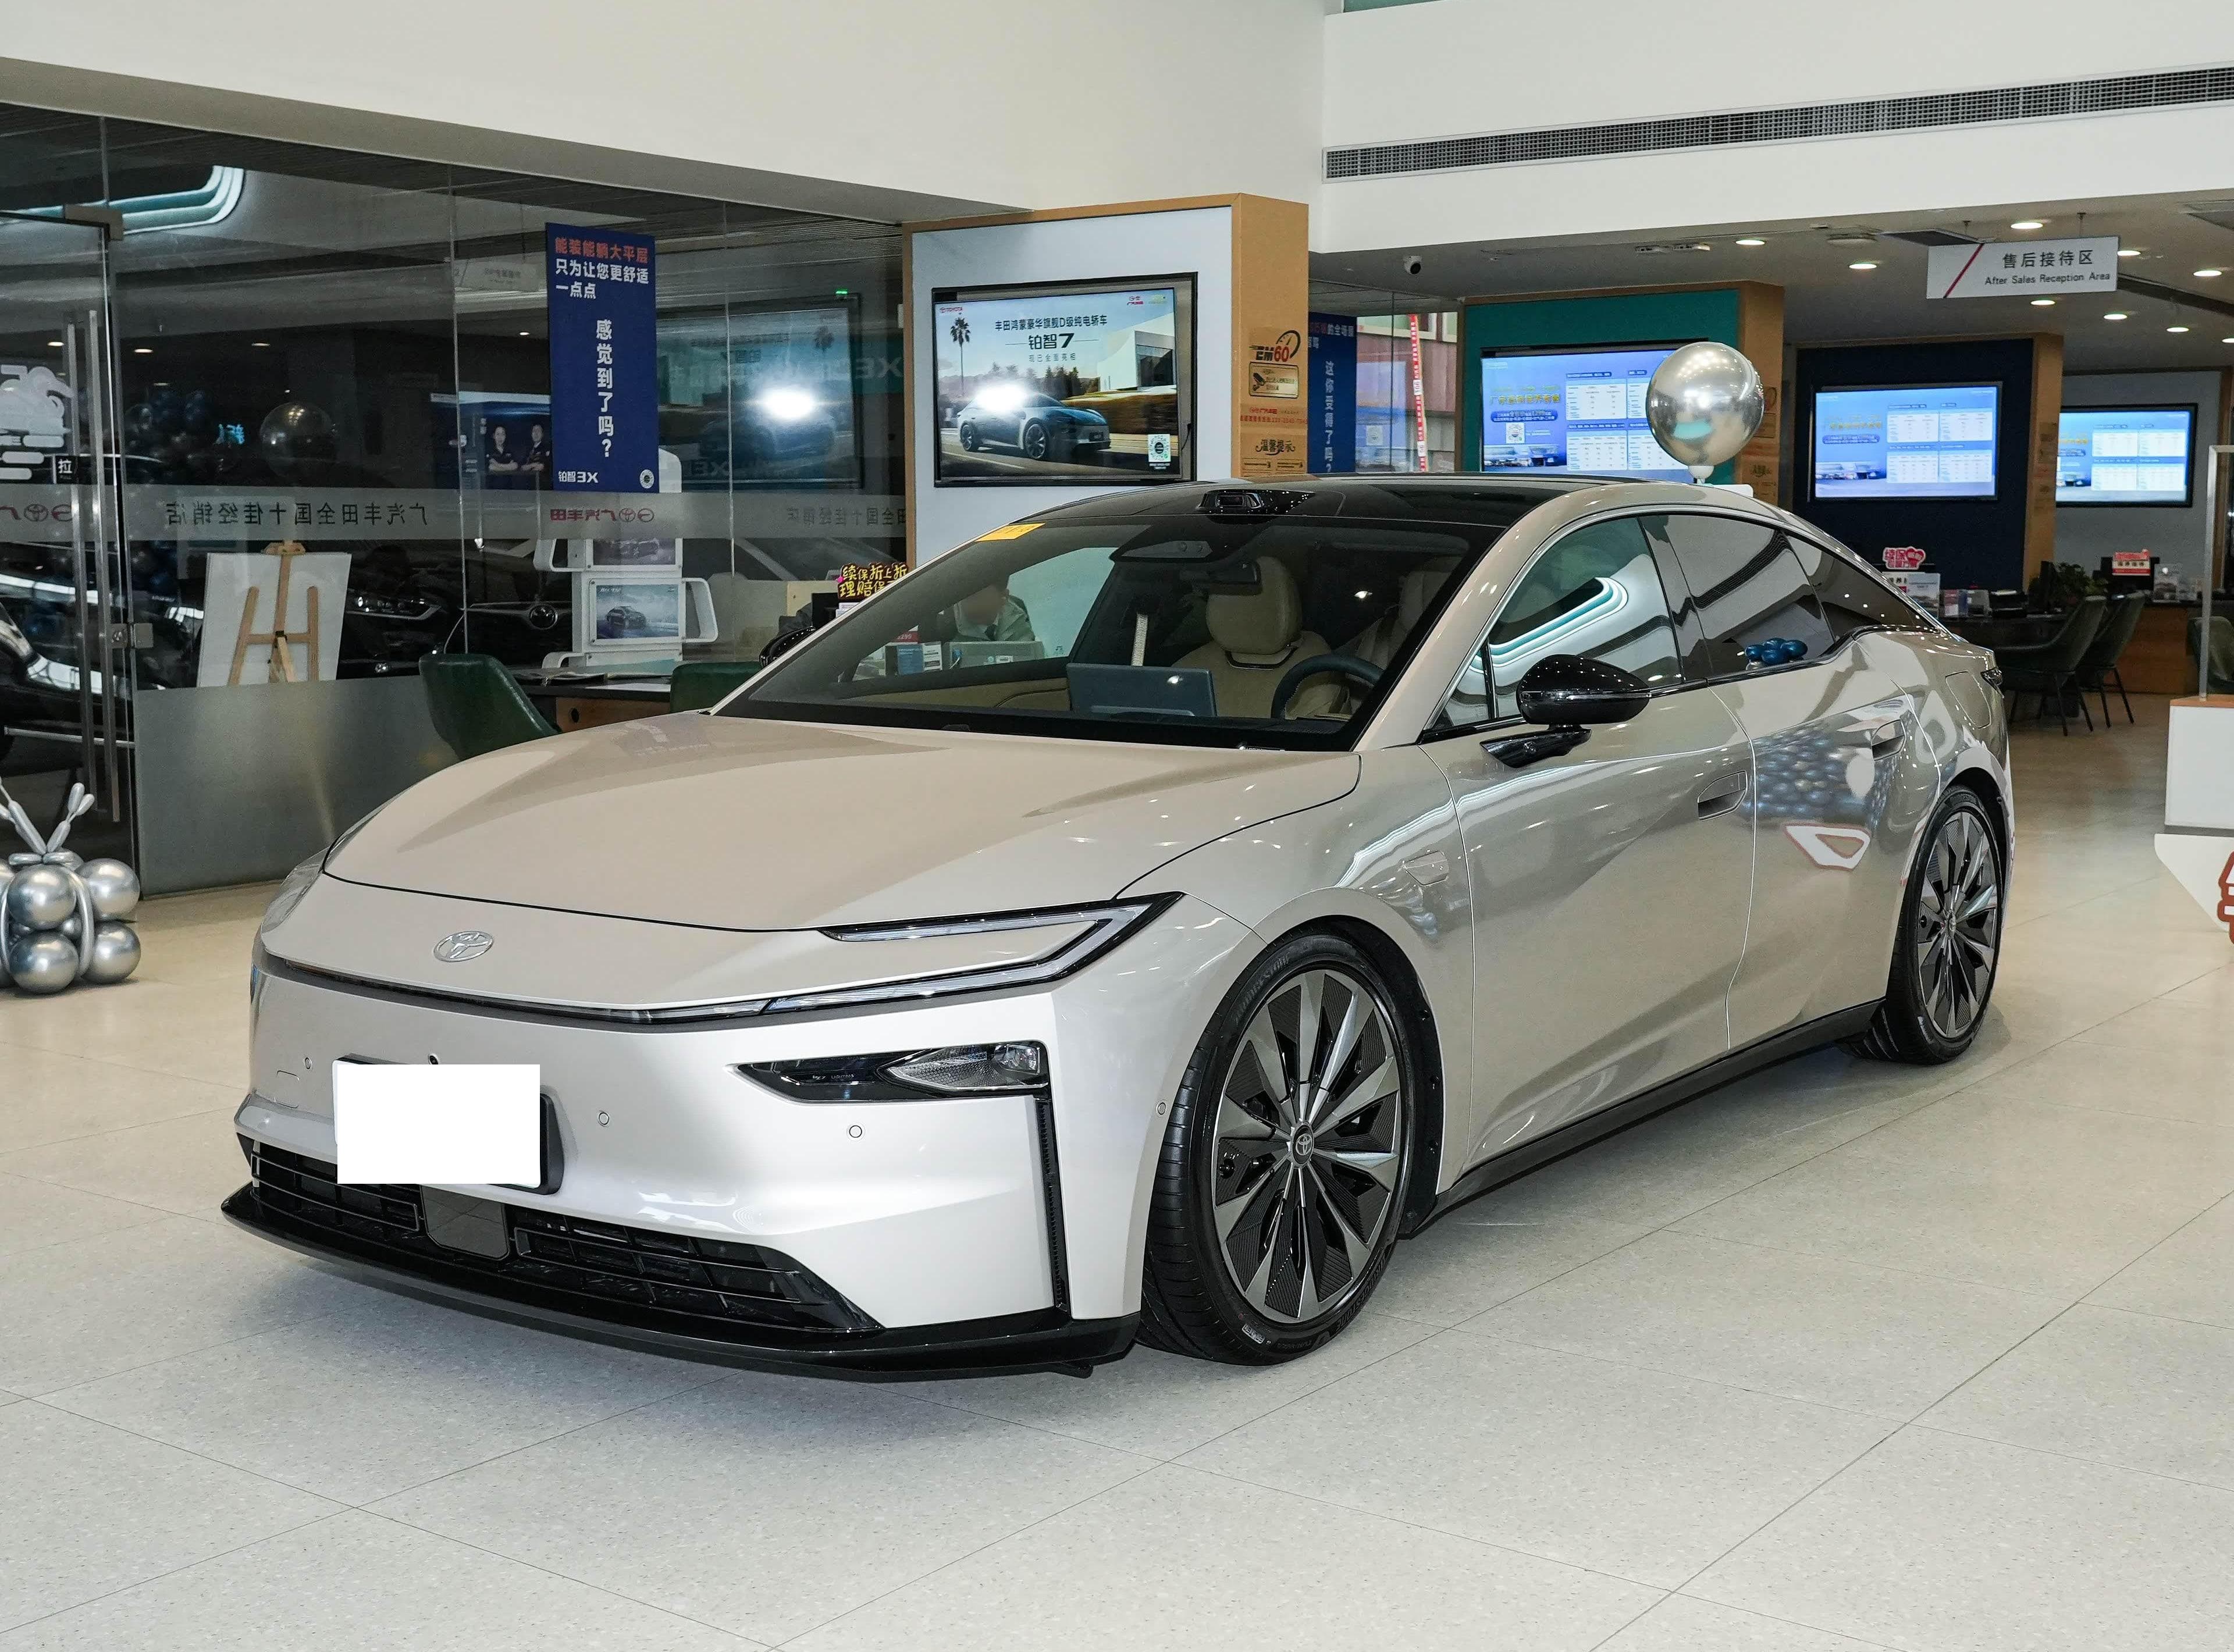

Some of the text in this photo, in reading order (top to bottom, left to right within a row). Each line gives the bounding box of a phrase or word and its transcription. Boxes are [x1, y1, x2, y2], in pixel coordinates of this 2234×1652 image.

[2002, 250, 2093, 268] 售后接待区
[556, 258, 649, 284] 只为让您更舒适
[1985, 272, 2110, 285] After Sales Reception Area
[556, 281, 596, 300] 一点点
[1029, 333, 1075, 350] 铂智7
[58, 459, 72, 473] 拉
[839, 581, 897, 597] 理赔保
